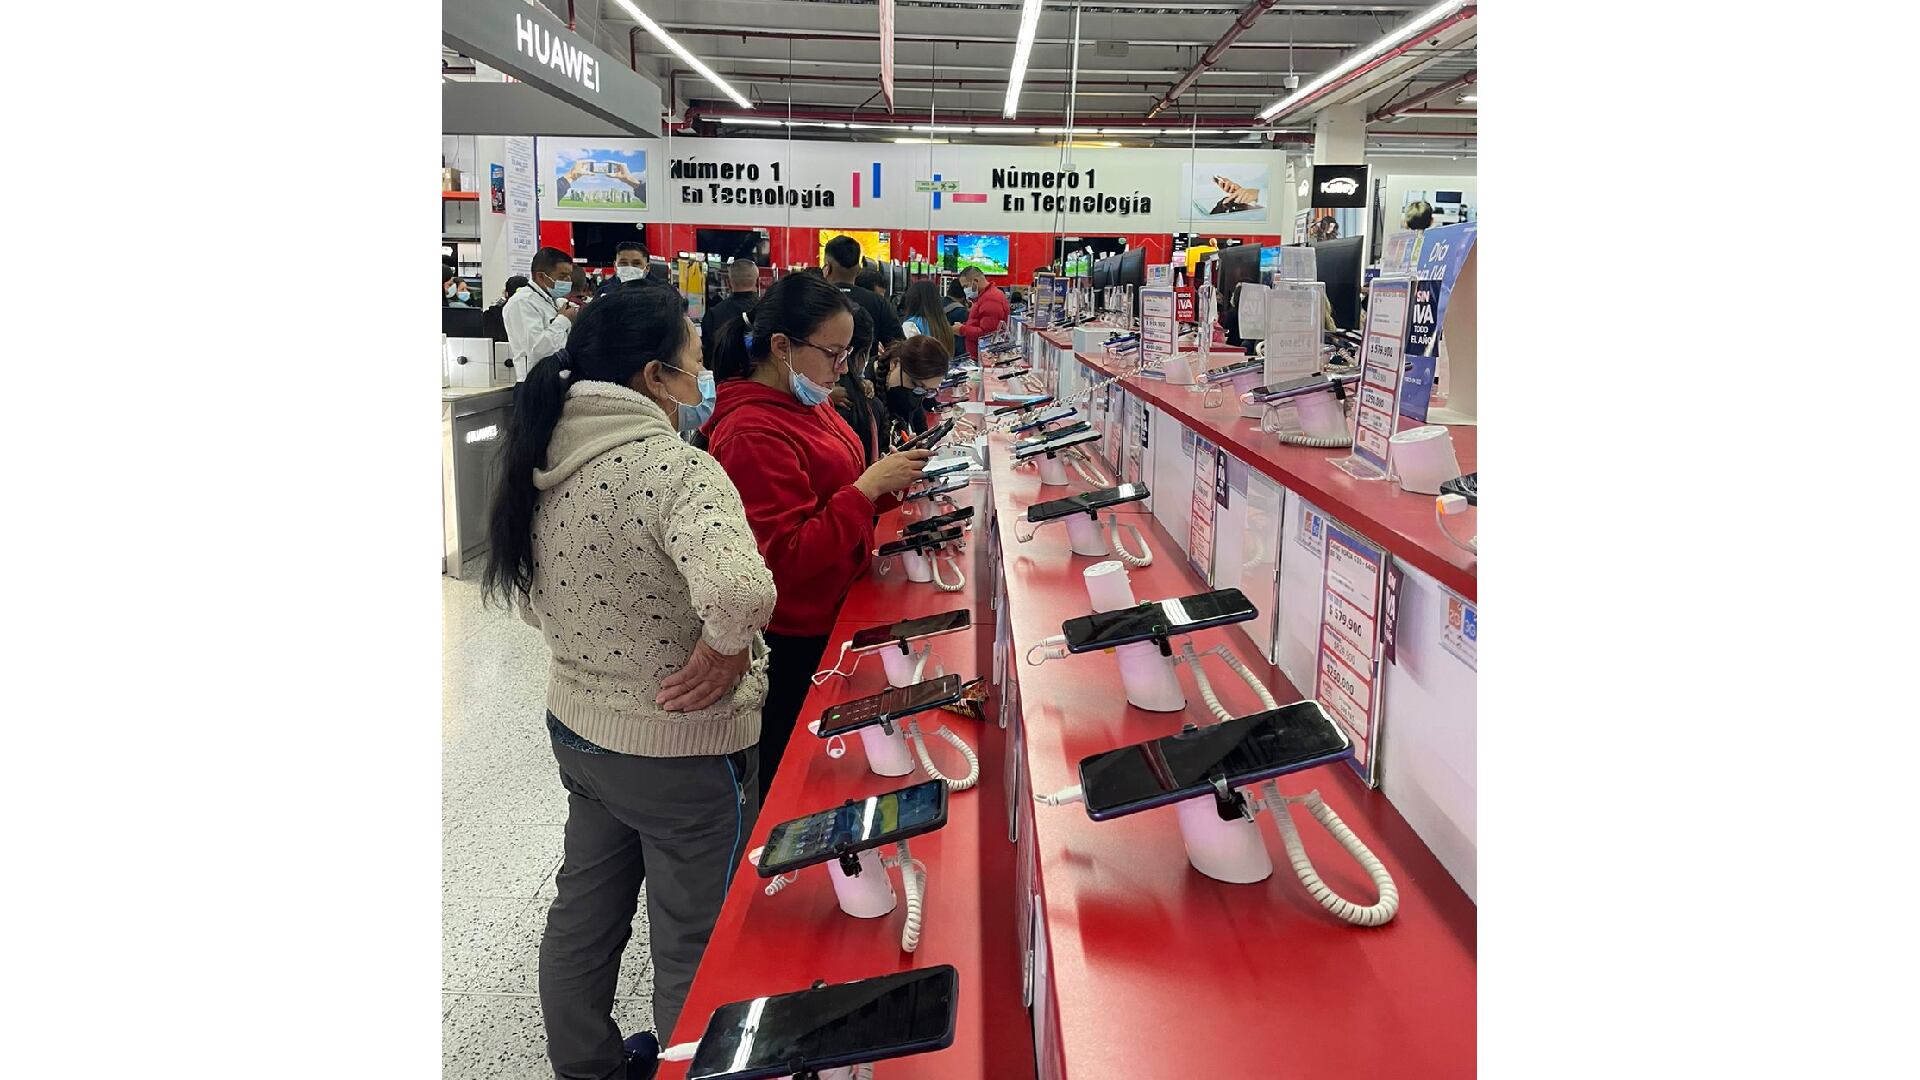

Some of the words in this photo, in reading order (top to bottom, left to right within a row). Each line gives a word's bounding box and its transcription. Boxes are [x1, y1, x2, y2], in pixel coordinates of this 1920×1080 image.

[515, 13, 600, 93] HUAWEI
[670, 156, 760, 181] Número
[770, 161, 780, 181] 1
[991, 165, 1080, 189] Número
[1085, 168, 1095, 189] 1
[682, 185, 702, 203] En
[708, 183, 835, 208] Tecnología
[1003, 194, 1024, 212] En
[1031, 190, 1151, 215] Tecnología
[1416, 291, 1430, 303] SIN
[1412, 304, 1434, 324] IVA
